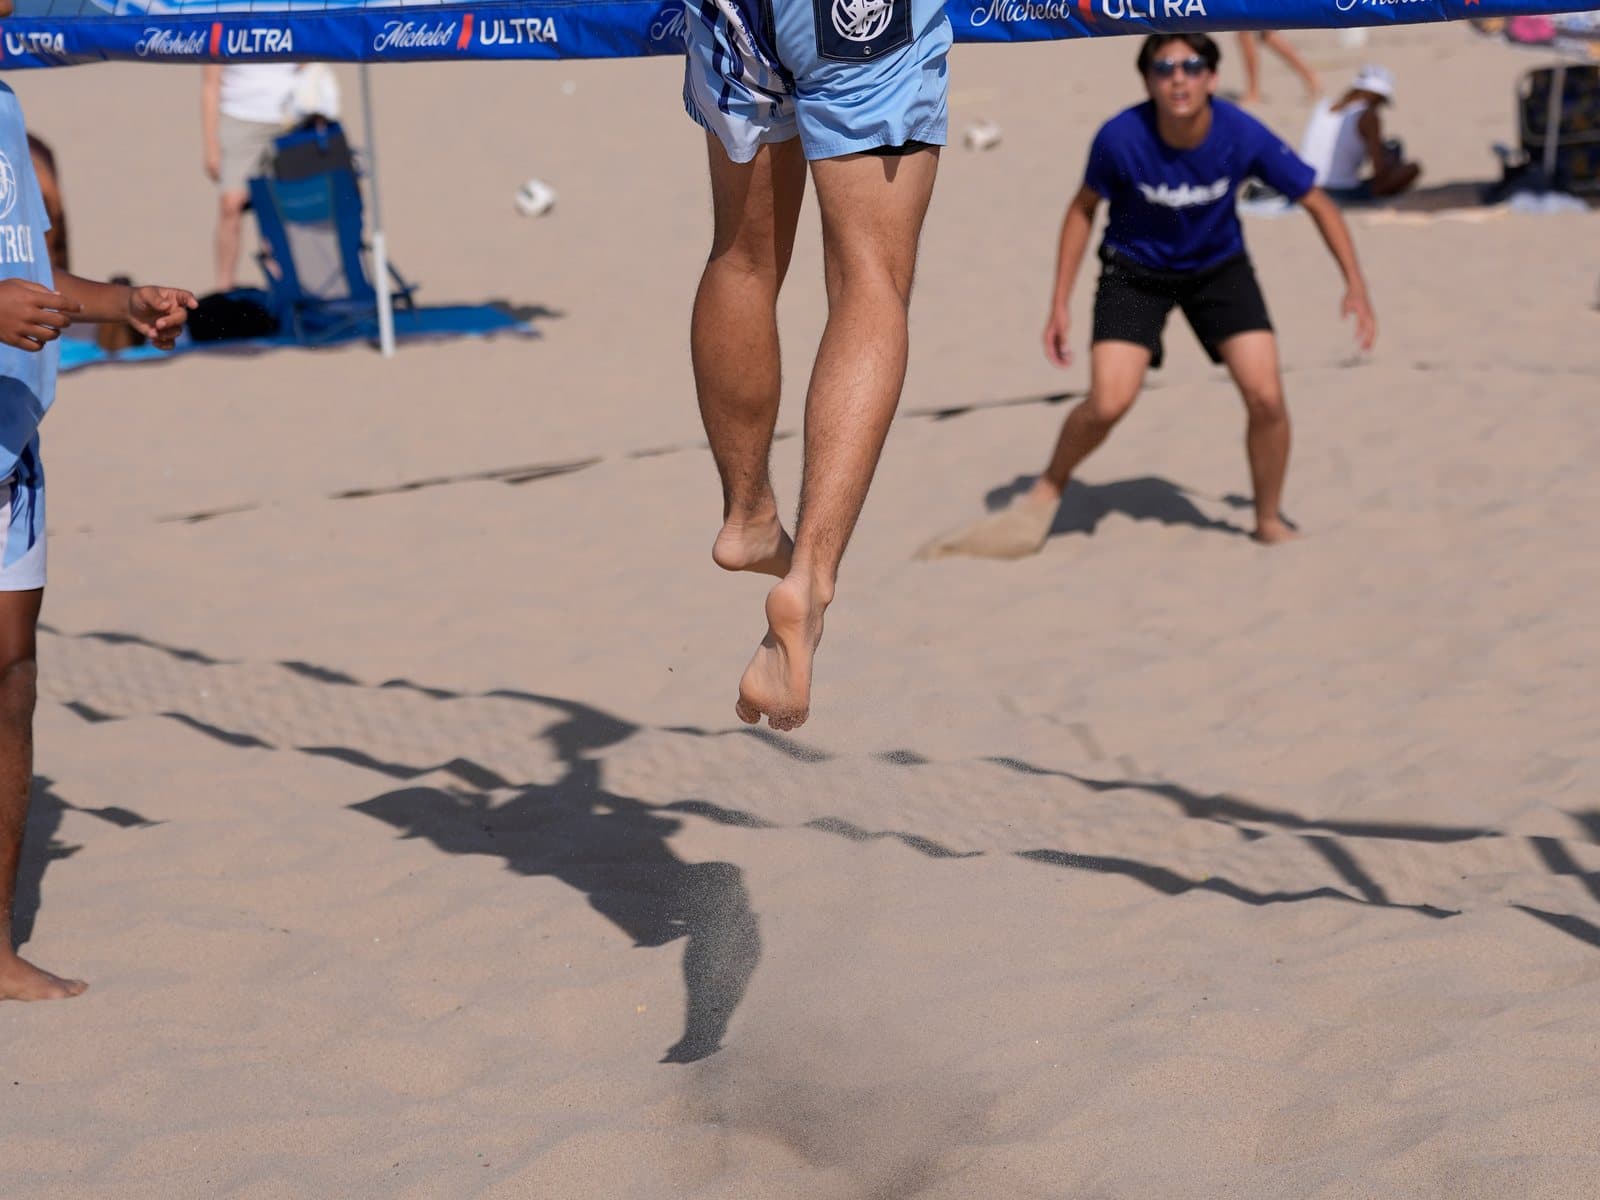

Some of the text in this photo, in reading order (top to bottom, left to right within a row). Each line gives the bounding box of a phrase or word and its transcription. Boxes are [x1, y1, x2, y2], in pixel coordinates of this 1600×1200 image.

[227, 27, 293, 54] ULTRA
[372, 16, 558, 52] Michelob ULTRA
